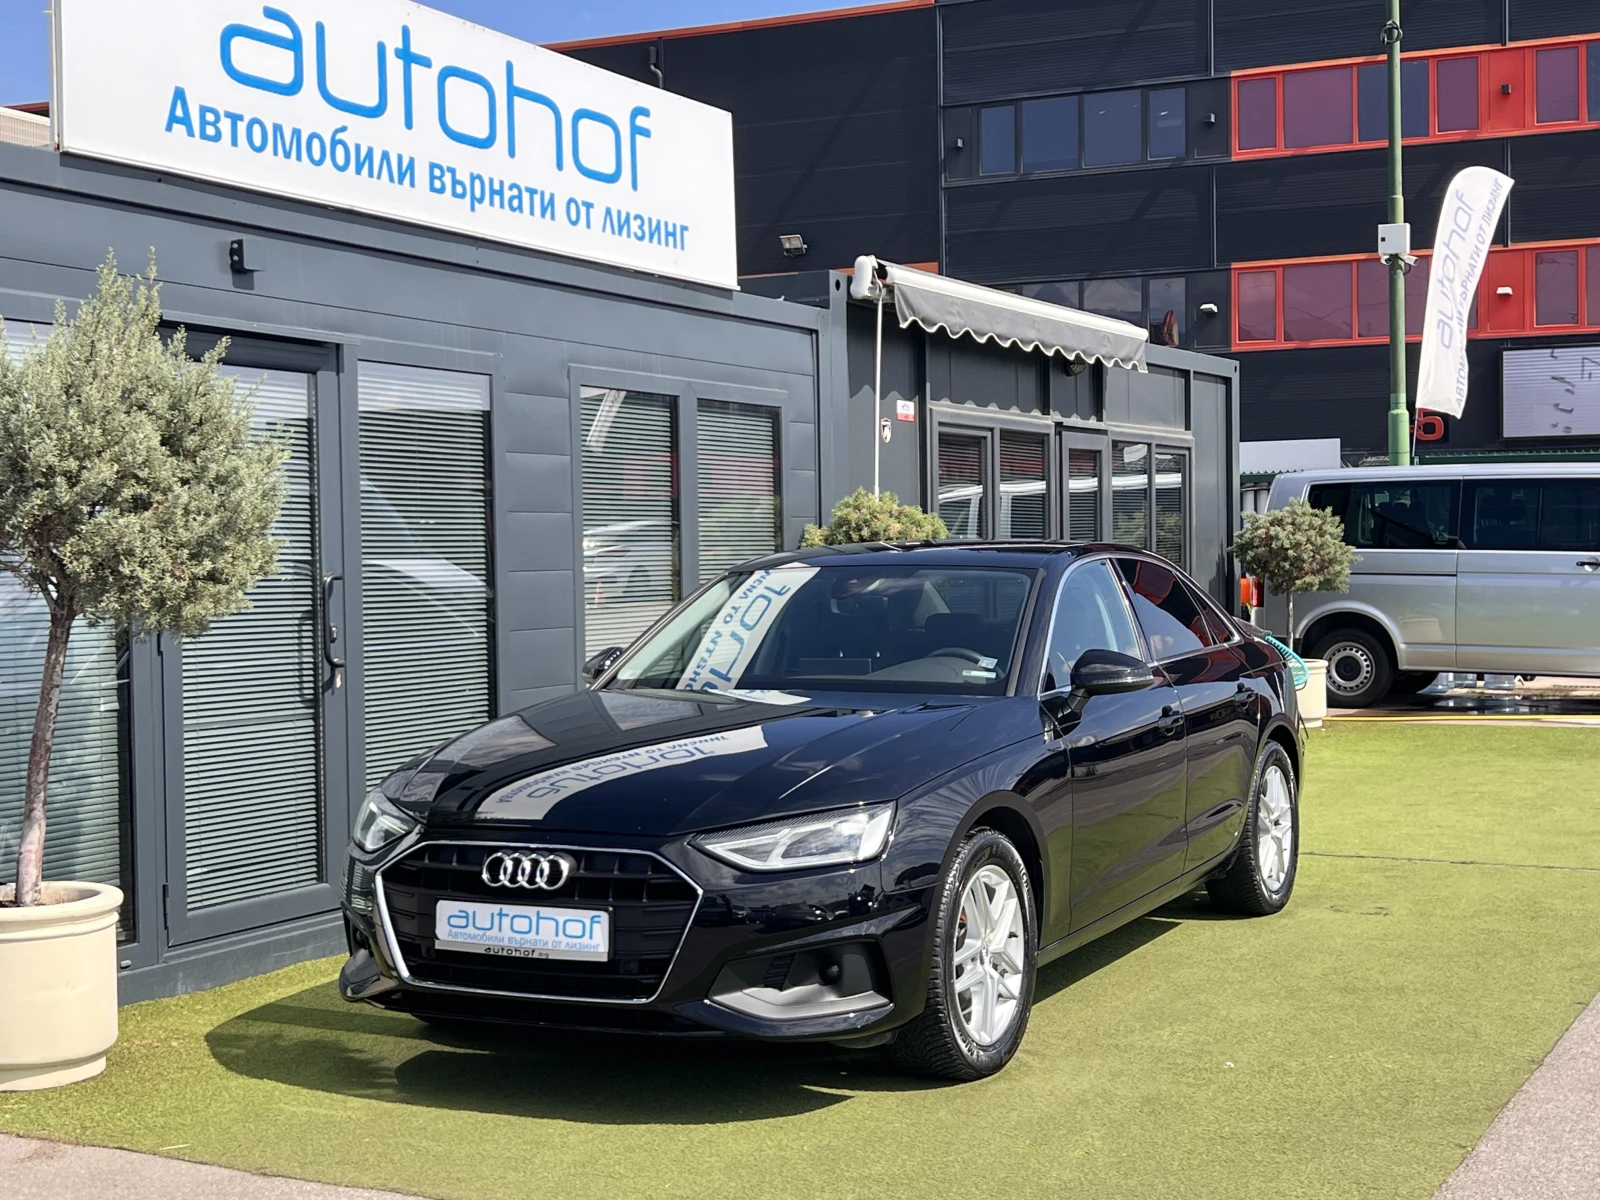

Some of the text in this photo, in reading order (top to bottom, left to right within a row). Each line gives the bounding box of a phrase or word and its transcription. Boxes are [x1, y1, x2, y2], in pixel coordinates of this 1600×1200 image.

[219, 5, 651, 191] autohof
[165, 85, 689, 251] Автомобили върнати от лизинг
[1436, 189, 1475, 350] autohof
[1476, 224, 1487, 245] ОТ
[447, 907, 601, 940] autohof
[447, 928, 601, 951] Автомобили върнати от лизинг
